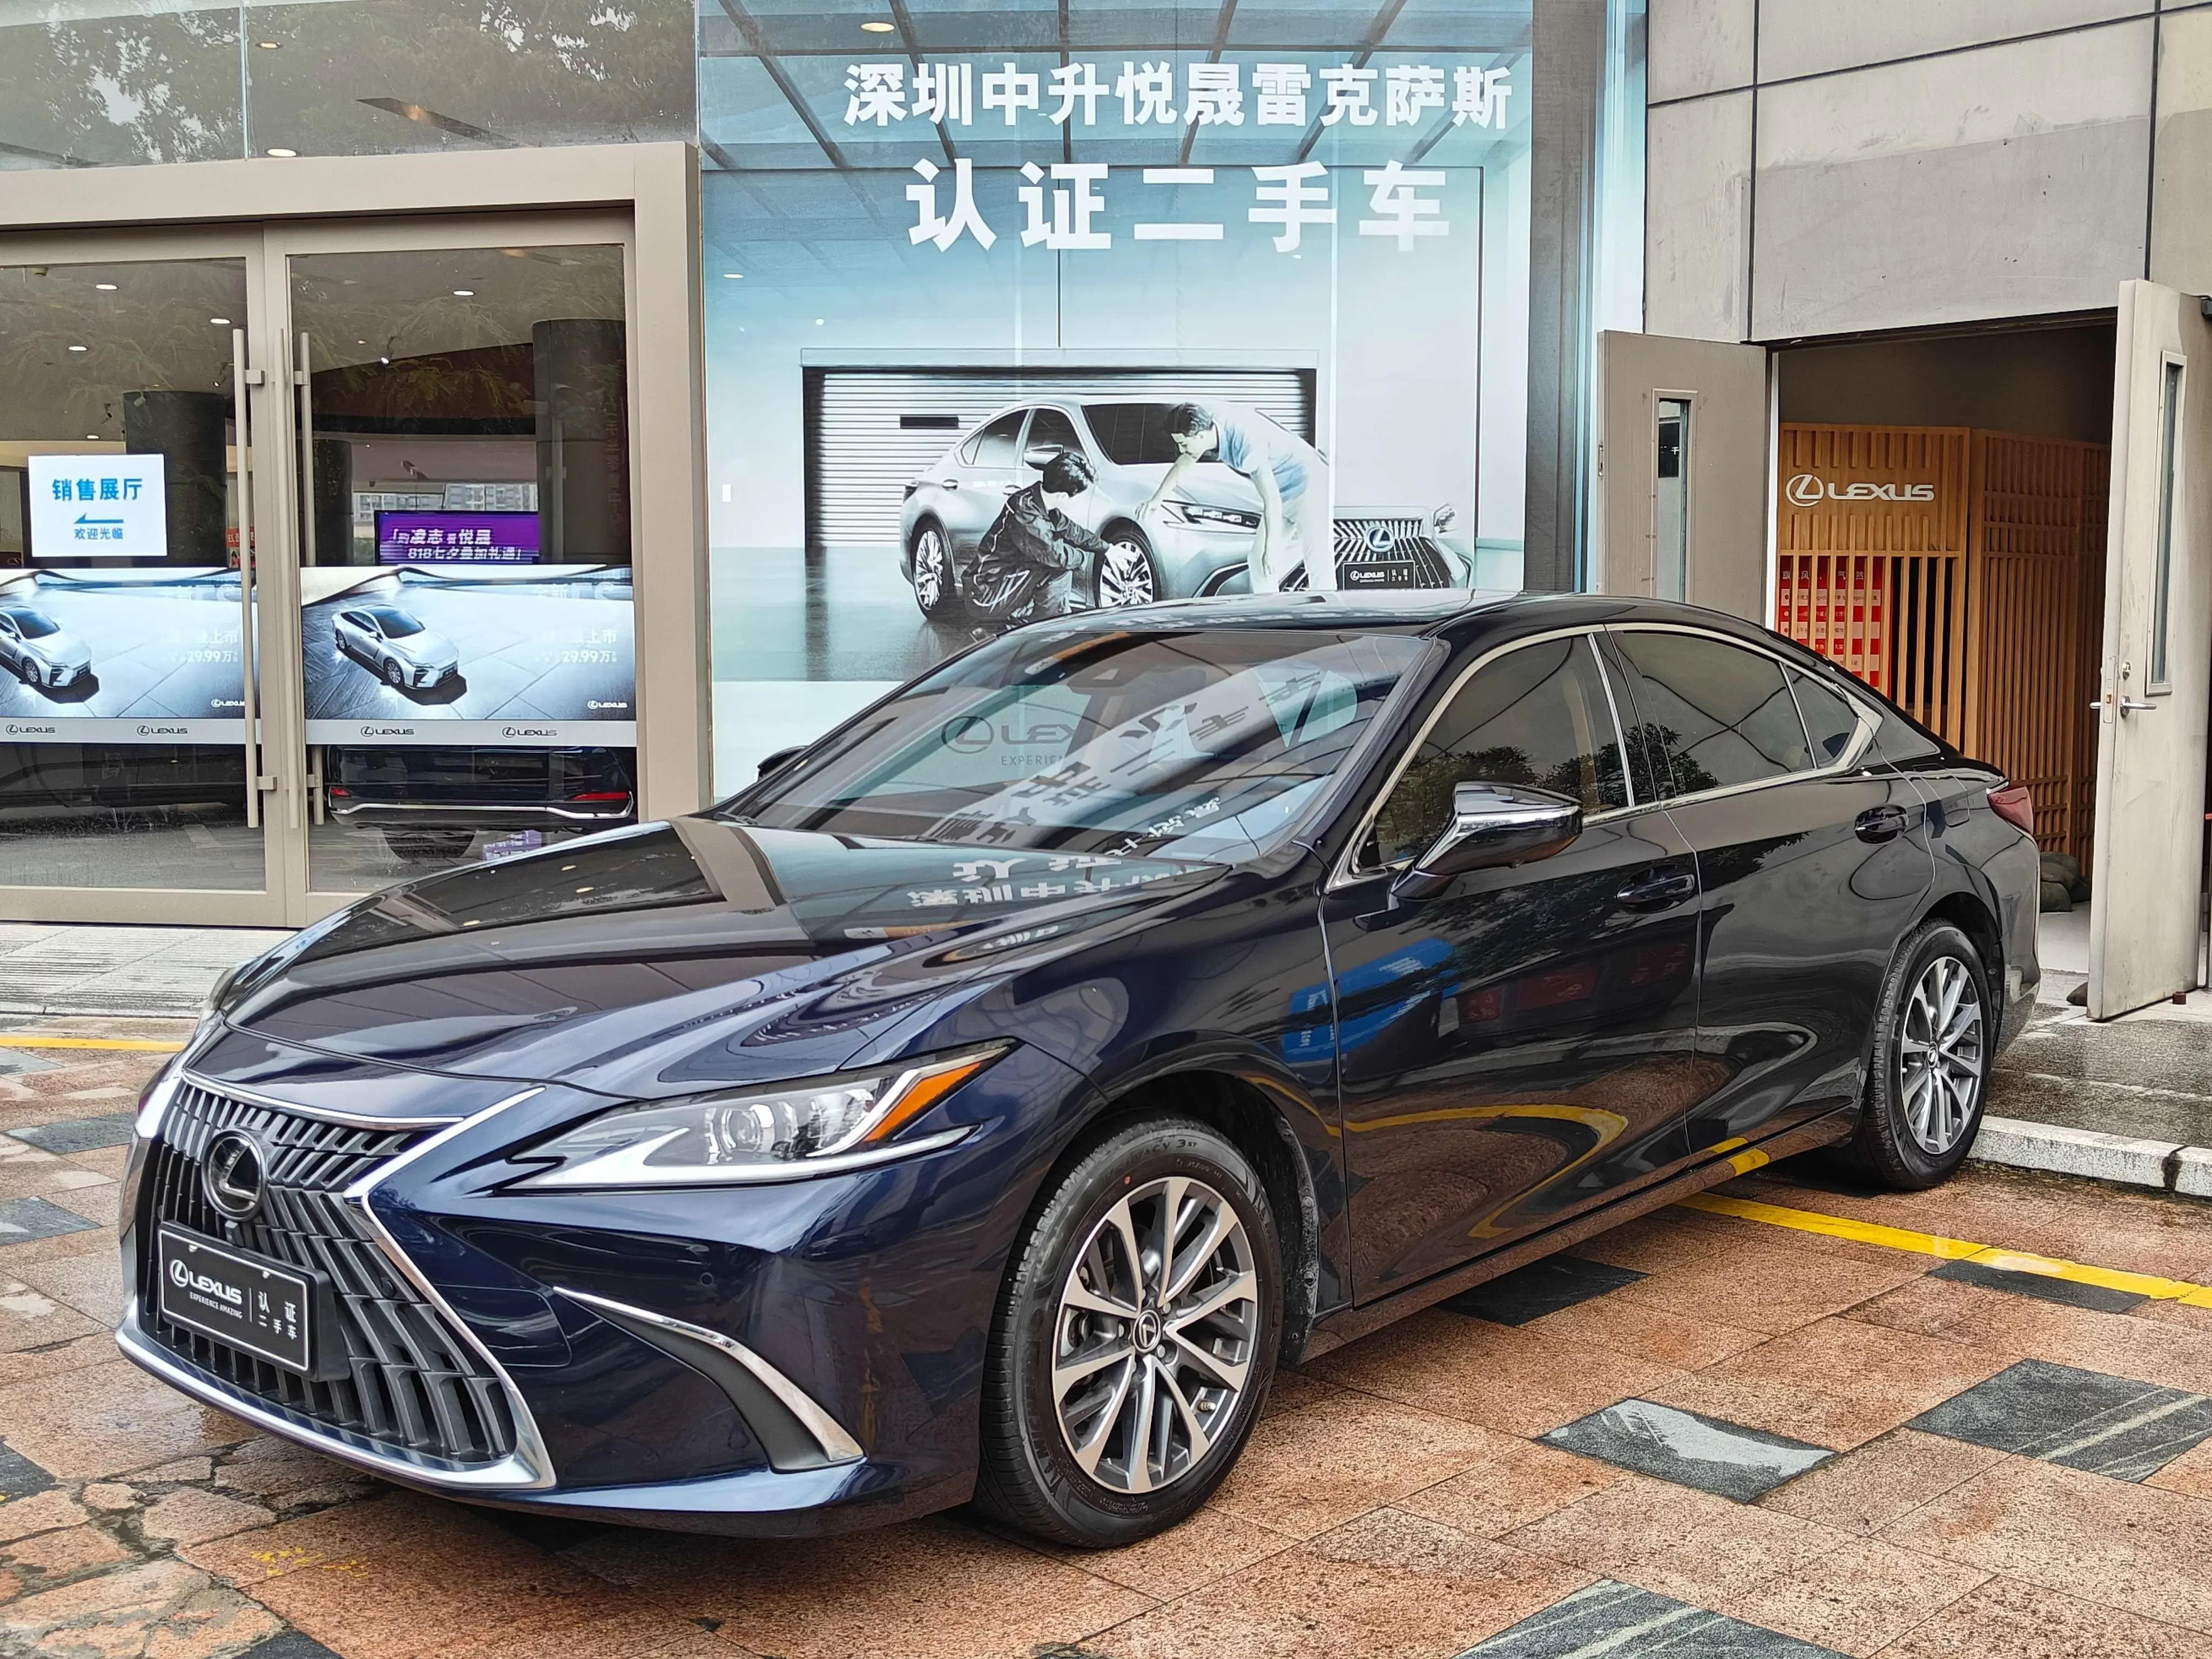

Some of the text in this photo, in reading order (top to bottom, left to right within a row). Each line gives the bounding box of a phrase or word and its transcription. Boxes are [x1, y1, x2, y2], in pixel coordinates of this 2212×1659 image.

[844, 61, 1512, 129] 深圳中升悦晟雷克萨斯
[906, 158, 1449, 252] 认证二手车
[52, 478, 143, 501] 销售展厅
[1827, 482, 1934, 501] LEXUS
[74, 527, 124, 540] 欢迎光临
[188, 1270, 242, 1305] LEXUS
[190, 1291, 243, 1319] EXPERIENCE AMAZING
[258, 1291, 297, 1323] 认证
[258, 1314, 297, 1340] 二手车
